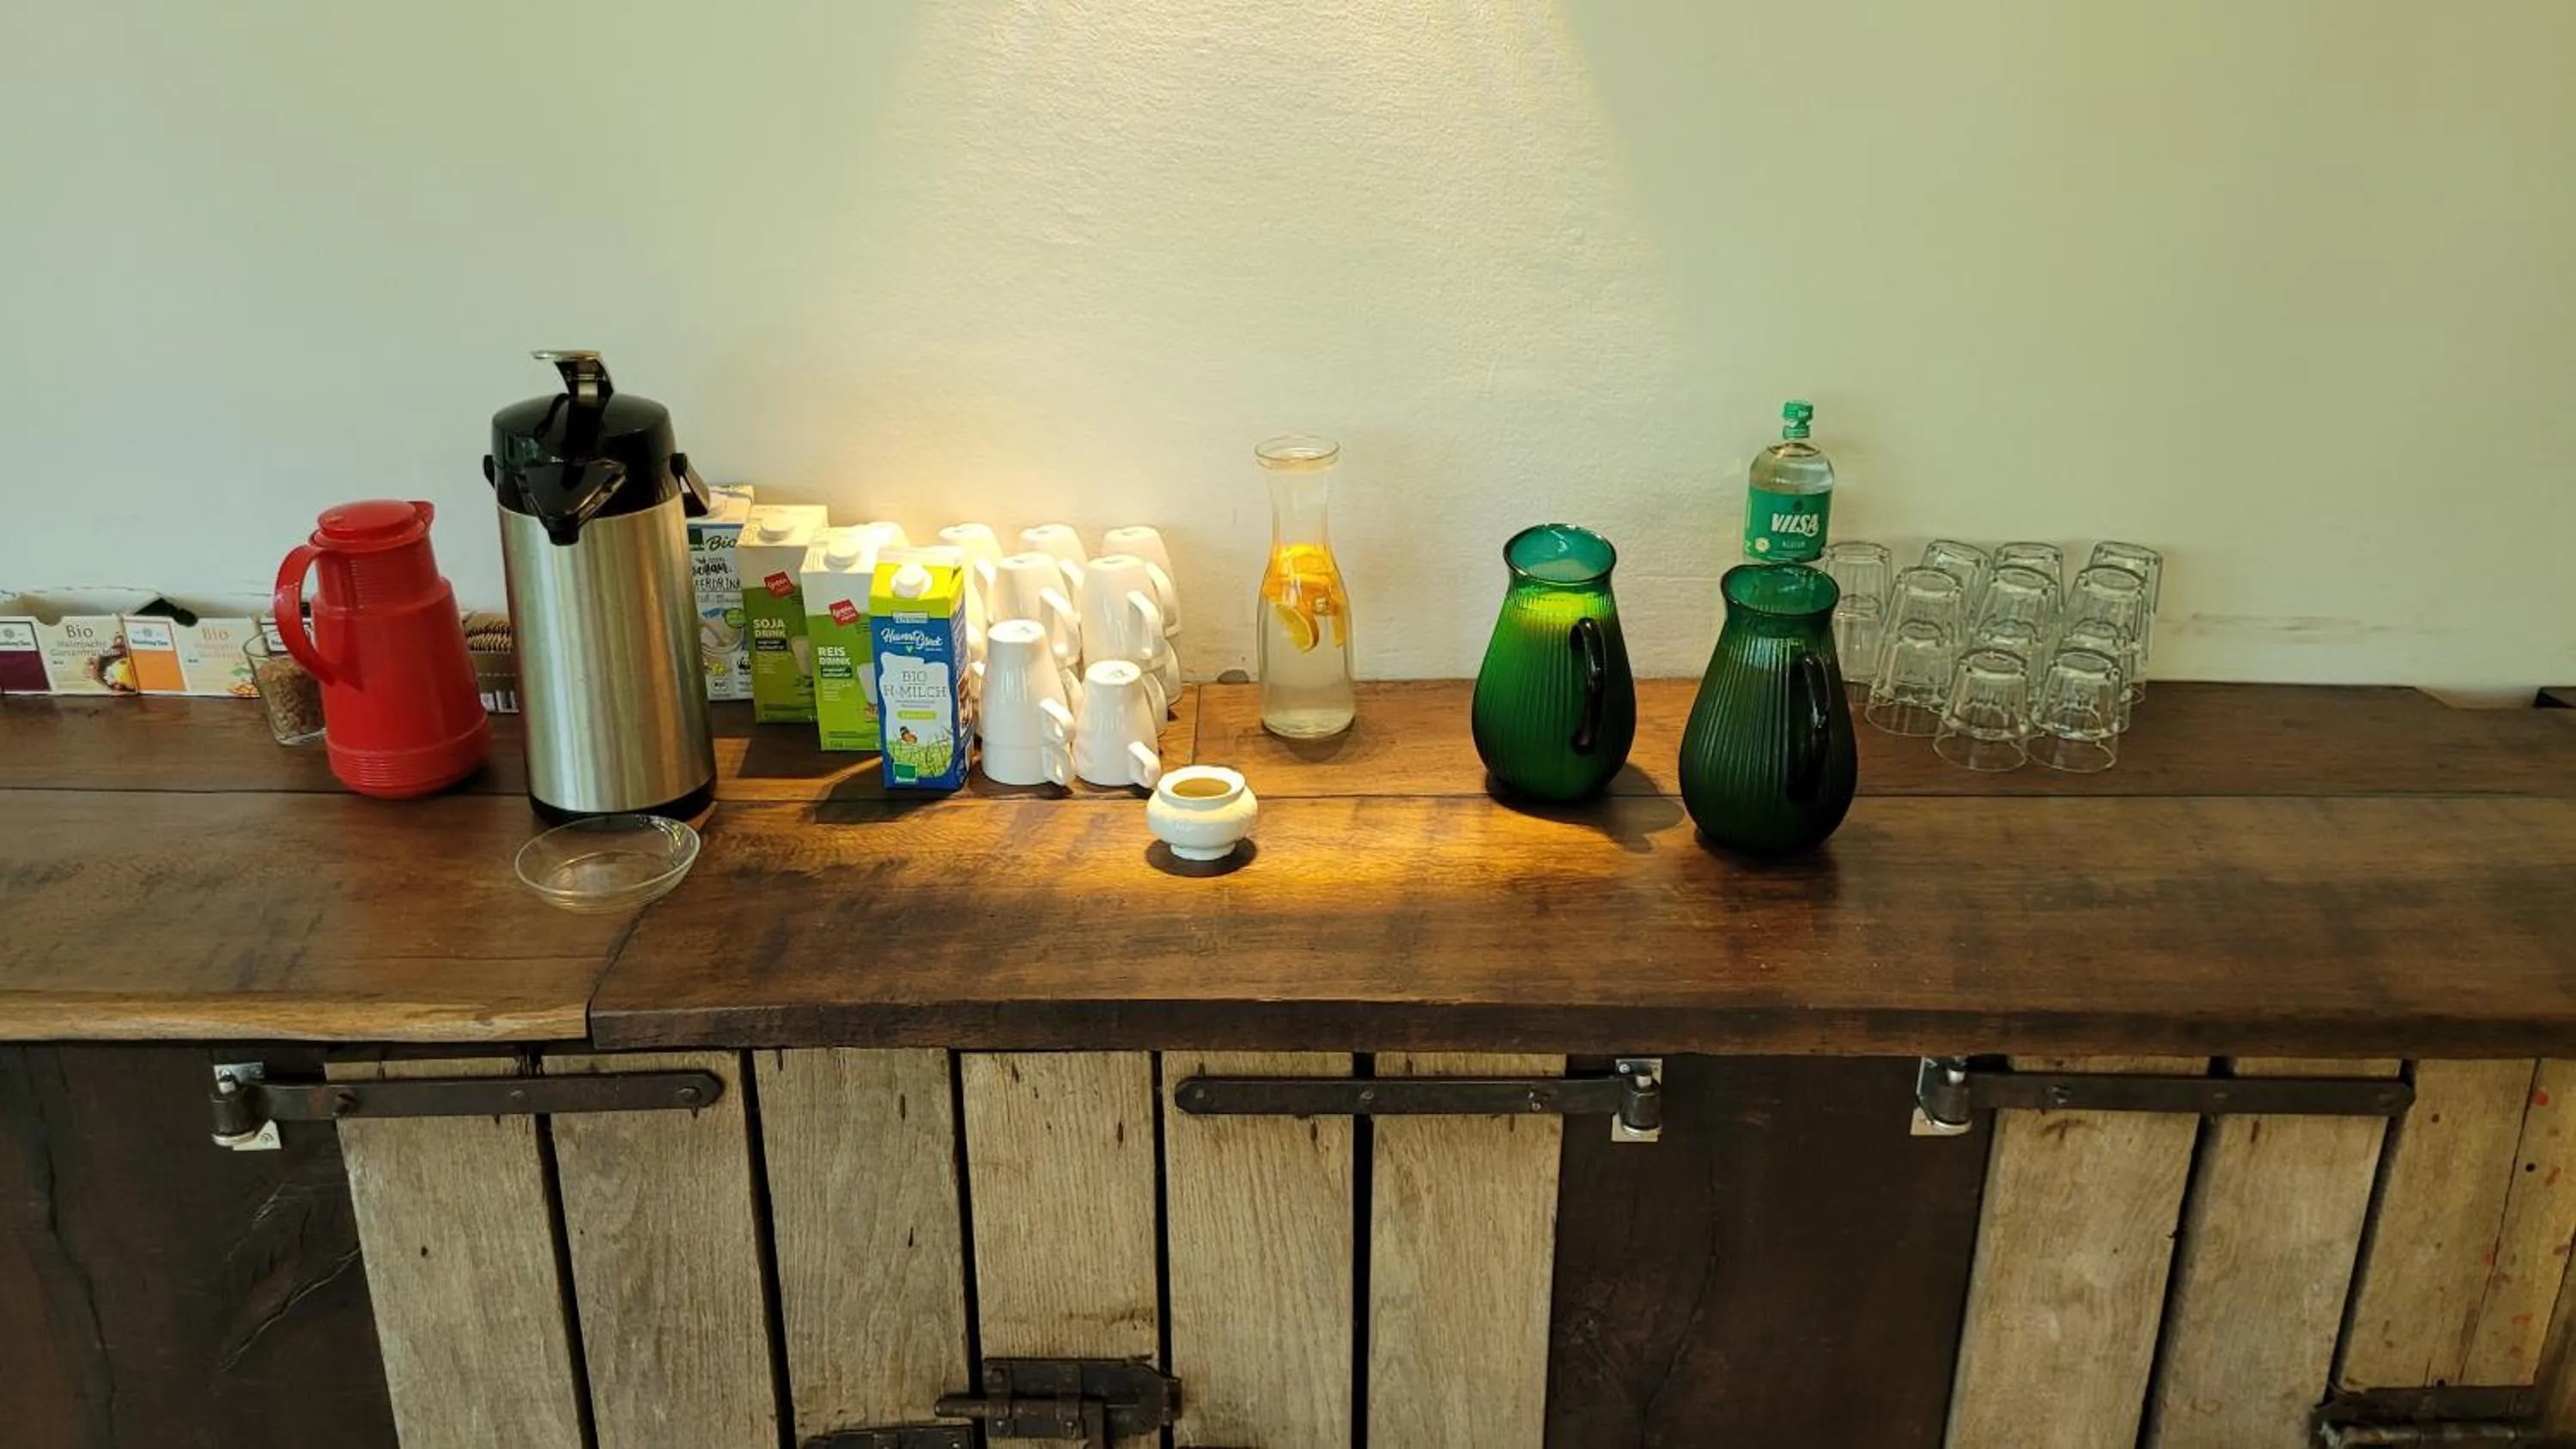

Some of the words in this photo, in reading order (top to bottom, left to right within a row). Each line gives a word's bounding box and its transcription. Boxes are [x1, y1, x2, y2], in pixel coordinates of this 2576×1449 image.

[1771, 512, 1819, 537] VILSA
[706, 536, 738, 550] Bio
[753, 619, 786, 629] SOJA
[66, 624, 94, 638] Bio
[755, 629, 786, 638] DRINK
[817, 646, 846, 657] REIS
[818, 657, 851, 666] DRINK
[902, 670, 927, 682] BIO
[883, 684, 946, 698] H-MILCH
